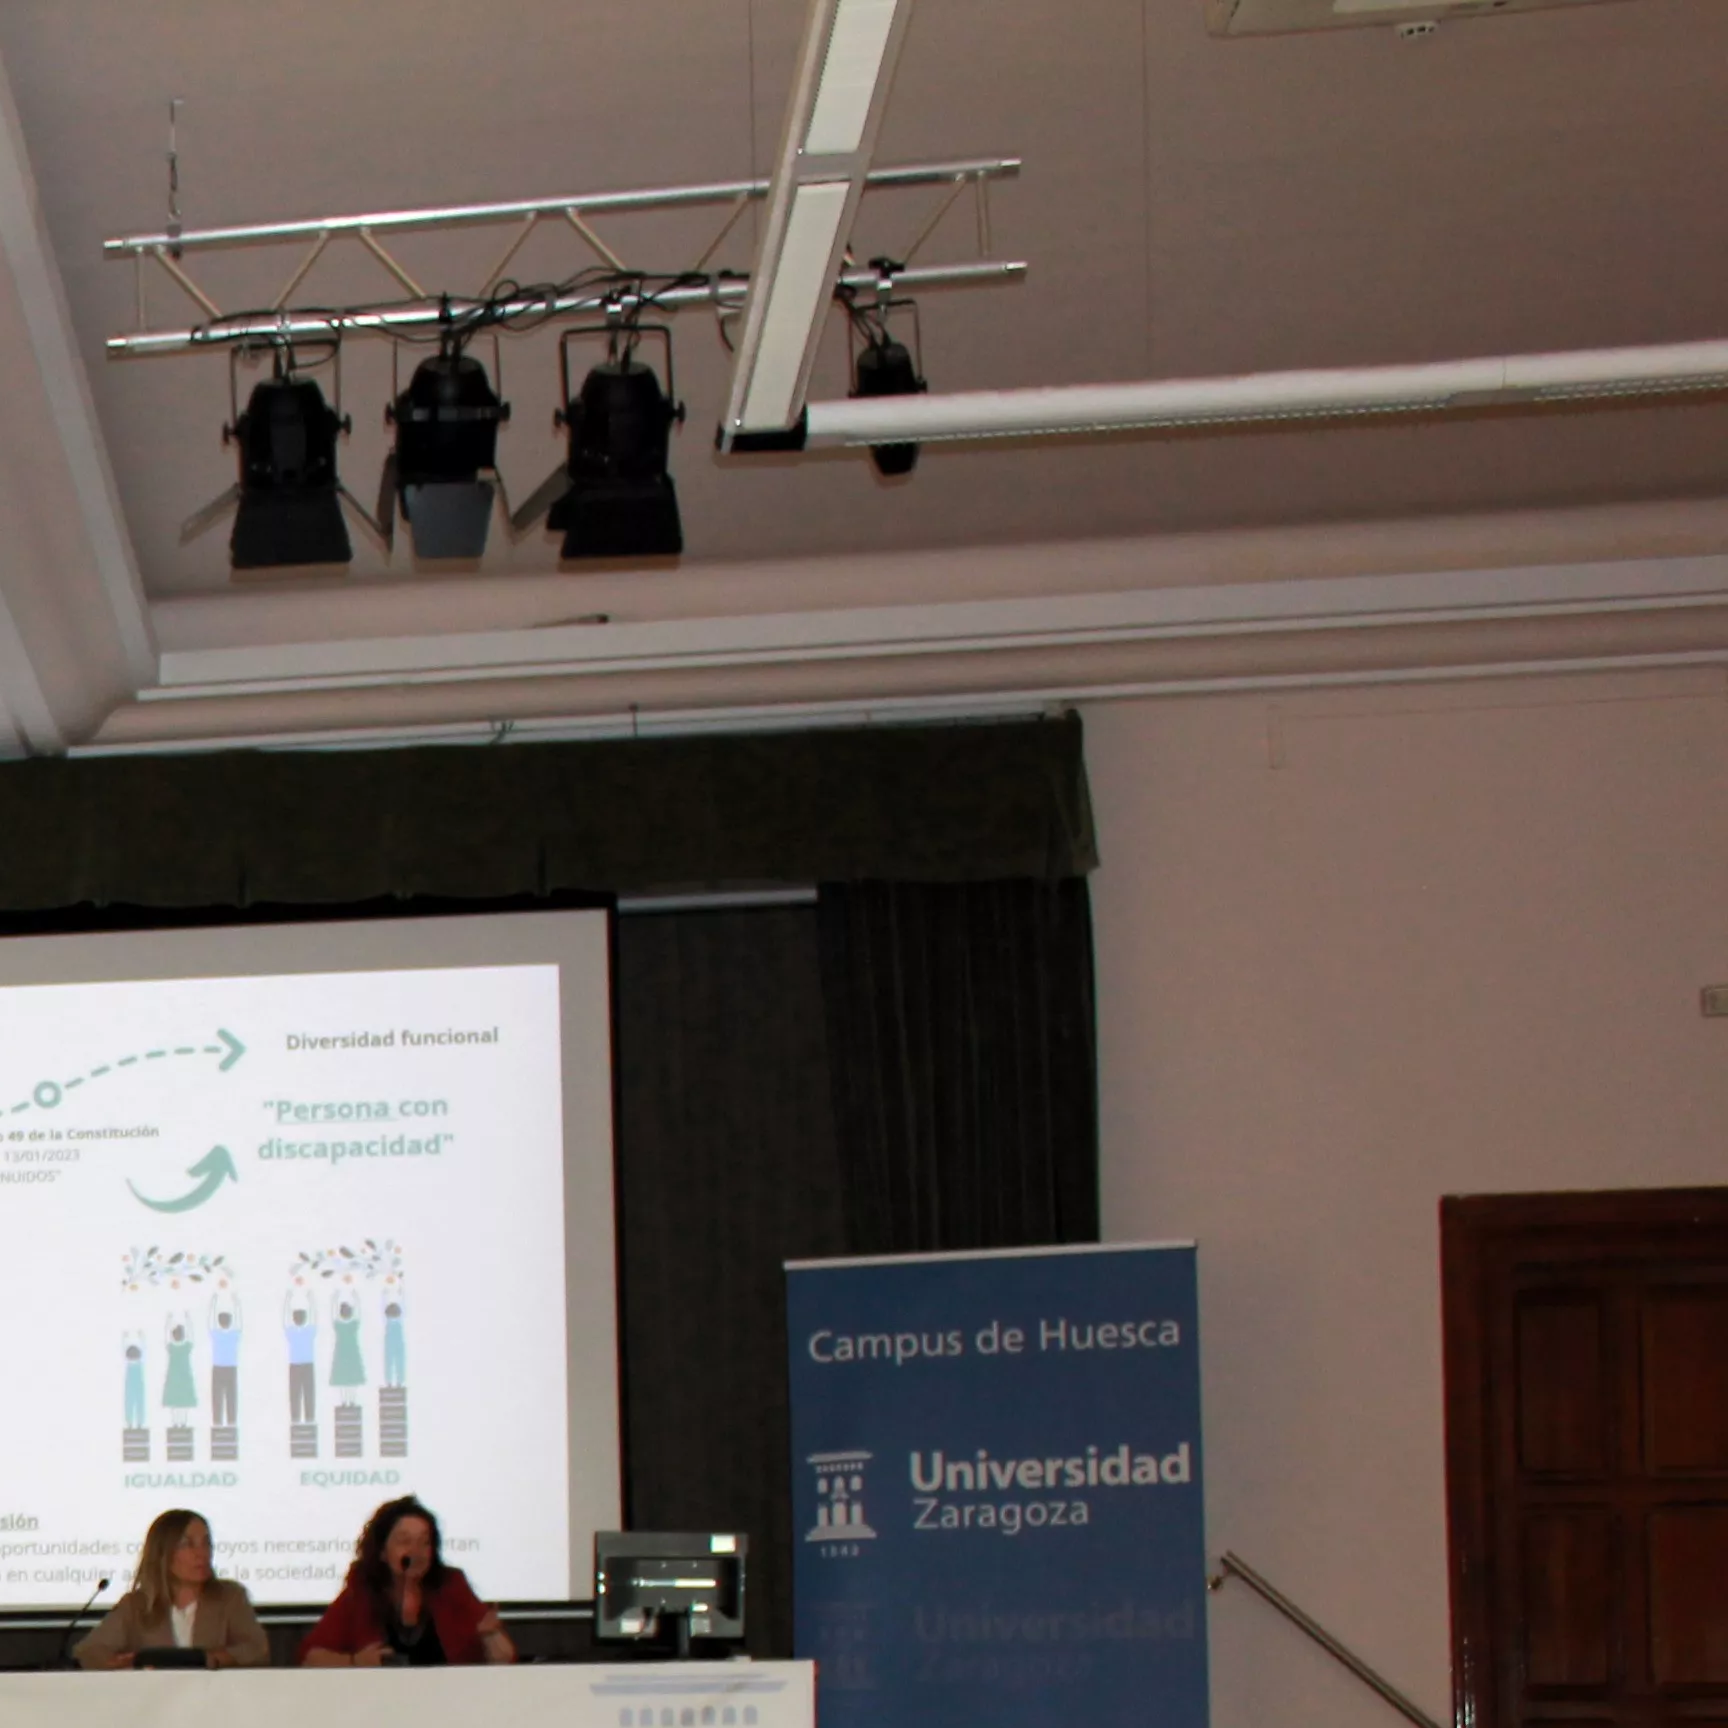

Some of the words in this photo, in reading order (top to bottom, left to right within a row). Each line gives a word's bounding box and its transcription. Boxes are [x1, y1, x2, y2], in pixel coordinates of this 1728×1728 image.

[285, 1031, 395, 1051] Diversidad
[401, 1026, 499, 1047] funcional
[263, 1099, 390, 1123] "Persona
[398, 1098, 448, 1117] con
[28, 1128, 47, 1142] de
[50, 1127, 63, 1141] la
[66, 1125, 160, 1141] Constitución
[257, 1133, 454, 1165] discapacidad"
[808, 1329, 962, 1365] Campus
[975, 1322, 1024, 1354] de
[1039, 1318, 1181, 1351] Huesca
[124, 1470, 240, 1489] IGUALDAD
[300, 1469, 401, 1488] EQUIDAD
[909, 1443, 1191, 1492] Universidad
[912, 1498, 1090, 1535] Zaragoza
[7, 1569, 28, 1584] en
[34, 1564, 116, 1586] cualquier
[235, 1562, 250, 1579] la
